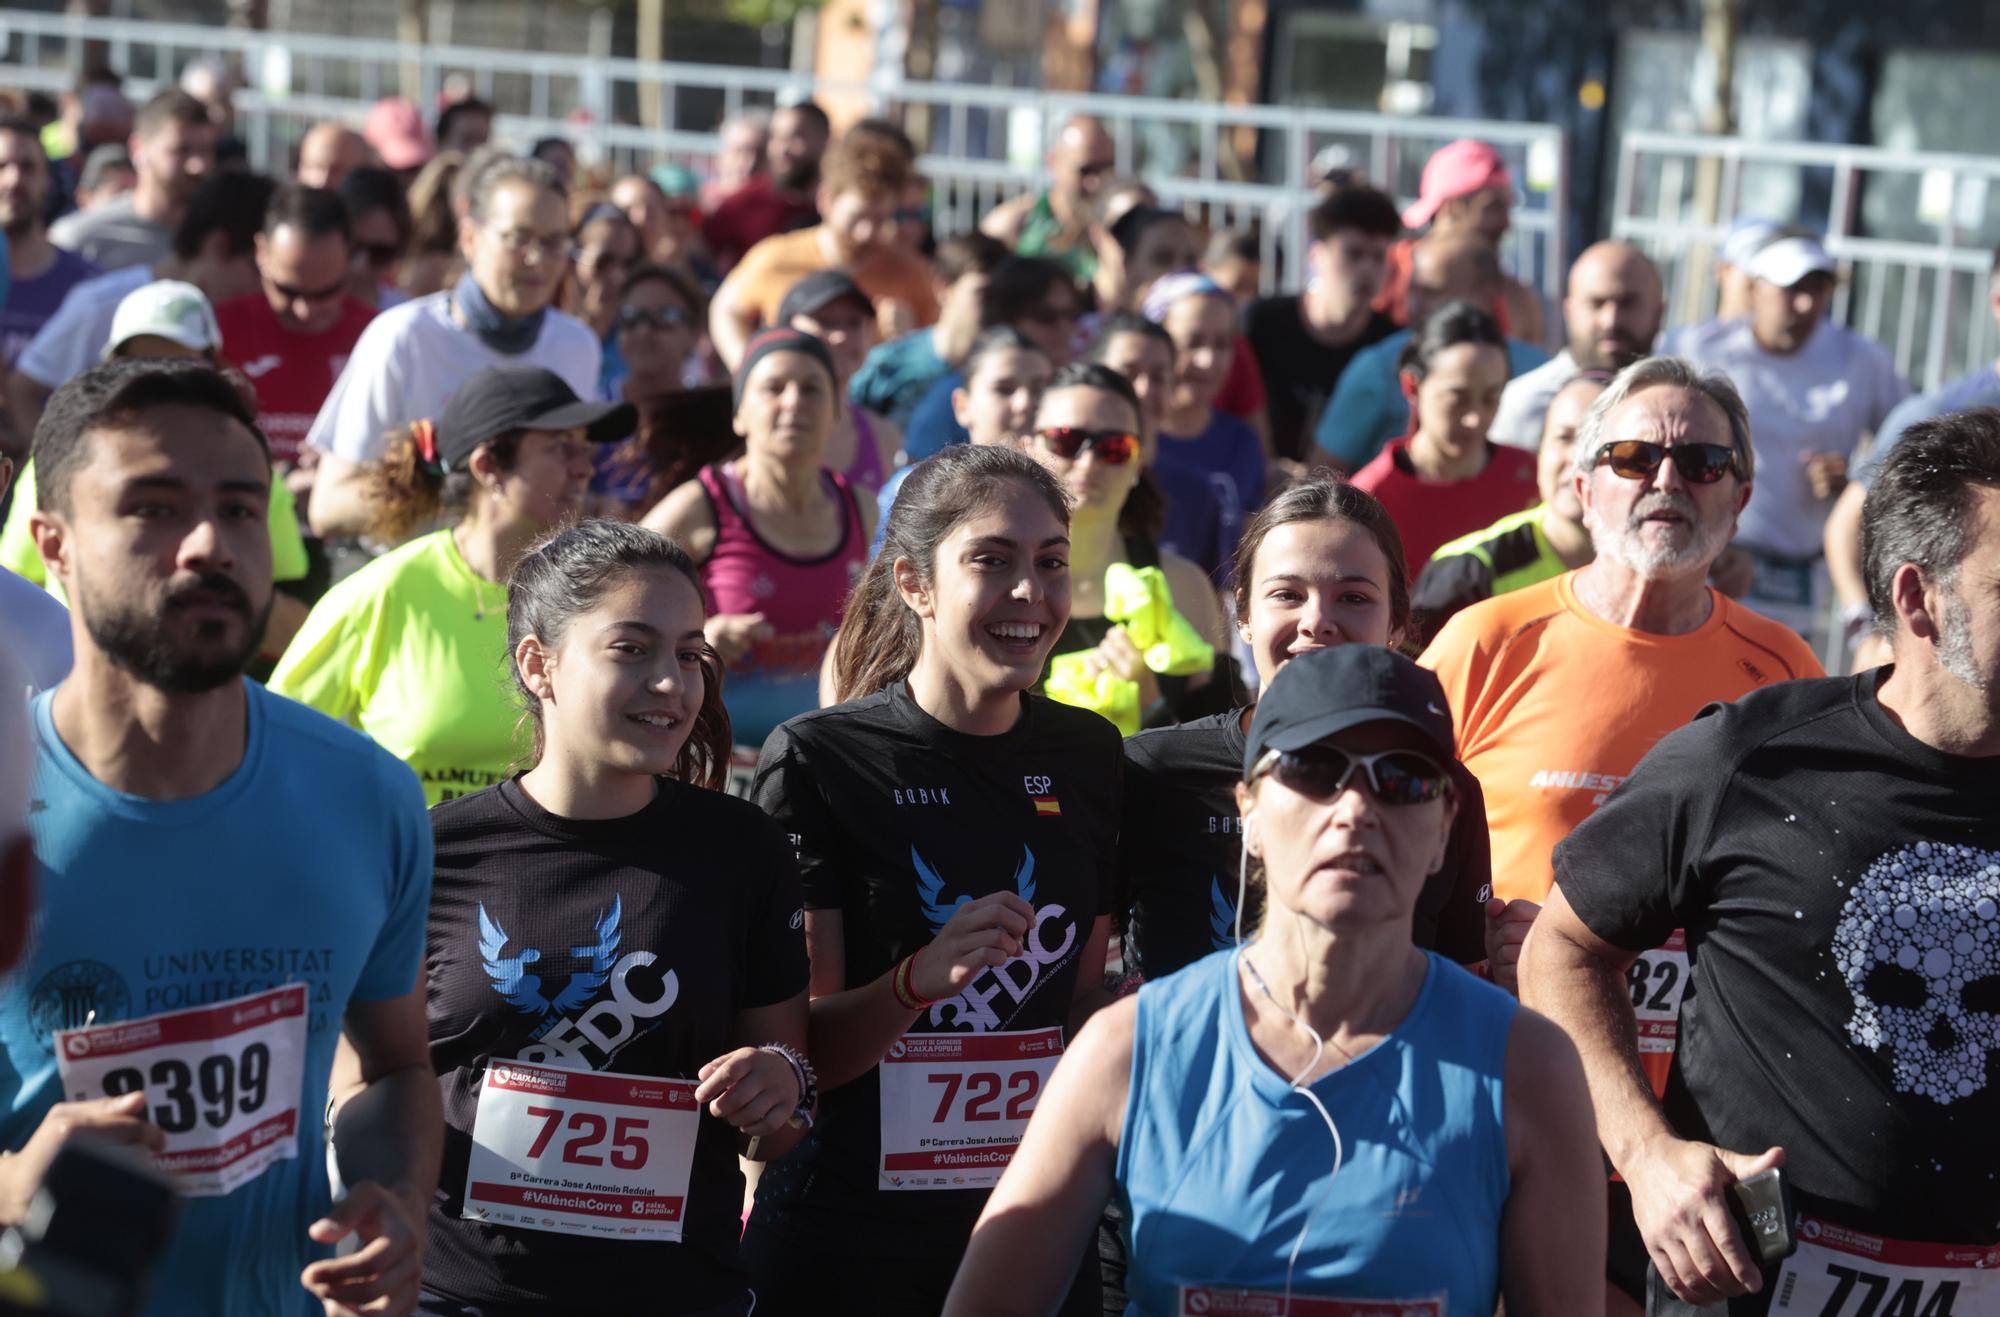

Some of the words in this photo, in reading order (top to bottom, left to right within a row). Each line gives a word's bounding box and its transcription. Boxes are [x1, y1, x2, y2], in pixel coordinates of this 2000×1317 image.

[893, 787, 951, 805] GOBIK
[1023, 776, 1051, 795] ESP
[143, 948, 334, 980] UNIVERSITAT
[927, 1070, 1040, 1123] 722
[526, 1105, 650, 1171] 725
[919, 1138, 931, 1147] 8ª
[931, 1137, 965, 1147] Carrera
[965, 1136, 986, 1145] Jose
[987, 1134, 1019, 1145] Antonio
[509, 1171, 522, 1181] 8ª
[522, 1173, 560, 1187] Carrera
[560, 1179, 584, 1190] Jose
[585, 1181, 622, 1194] Antonio
[621, 1185, 656, 1197] Redolat
[521, 1190, 623, 1214] #ValènciaCorre
[644, 1207, 675, 1216] popular
[1815, 1263, 1960, 1317] 7744
